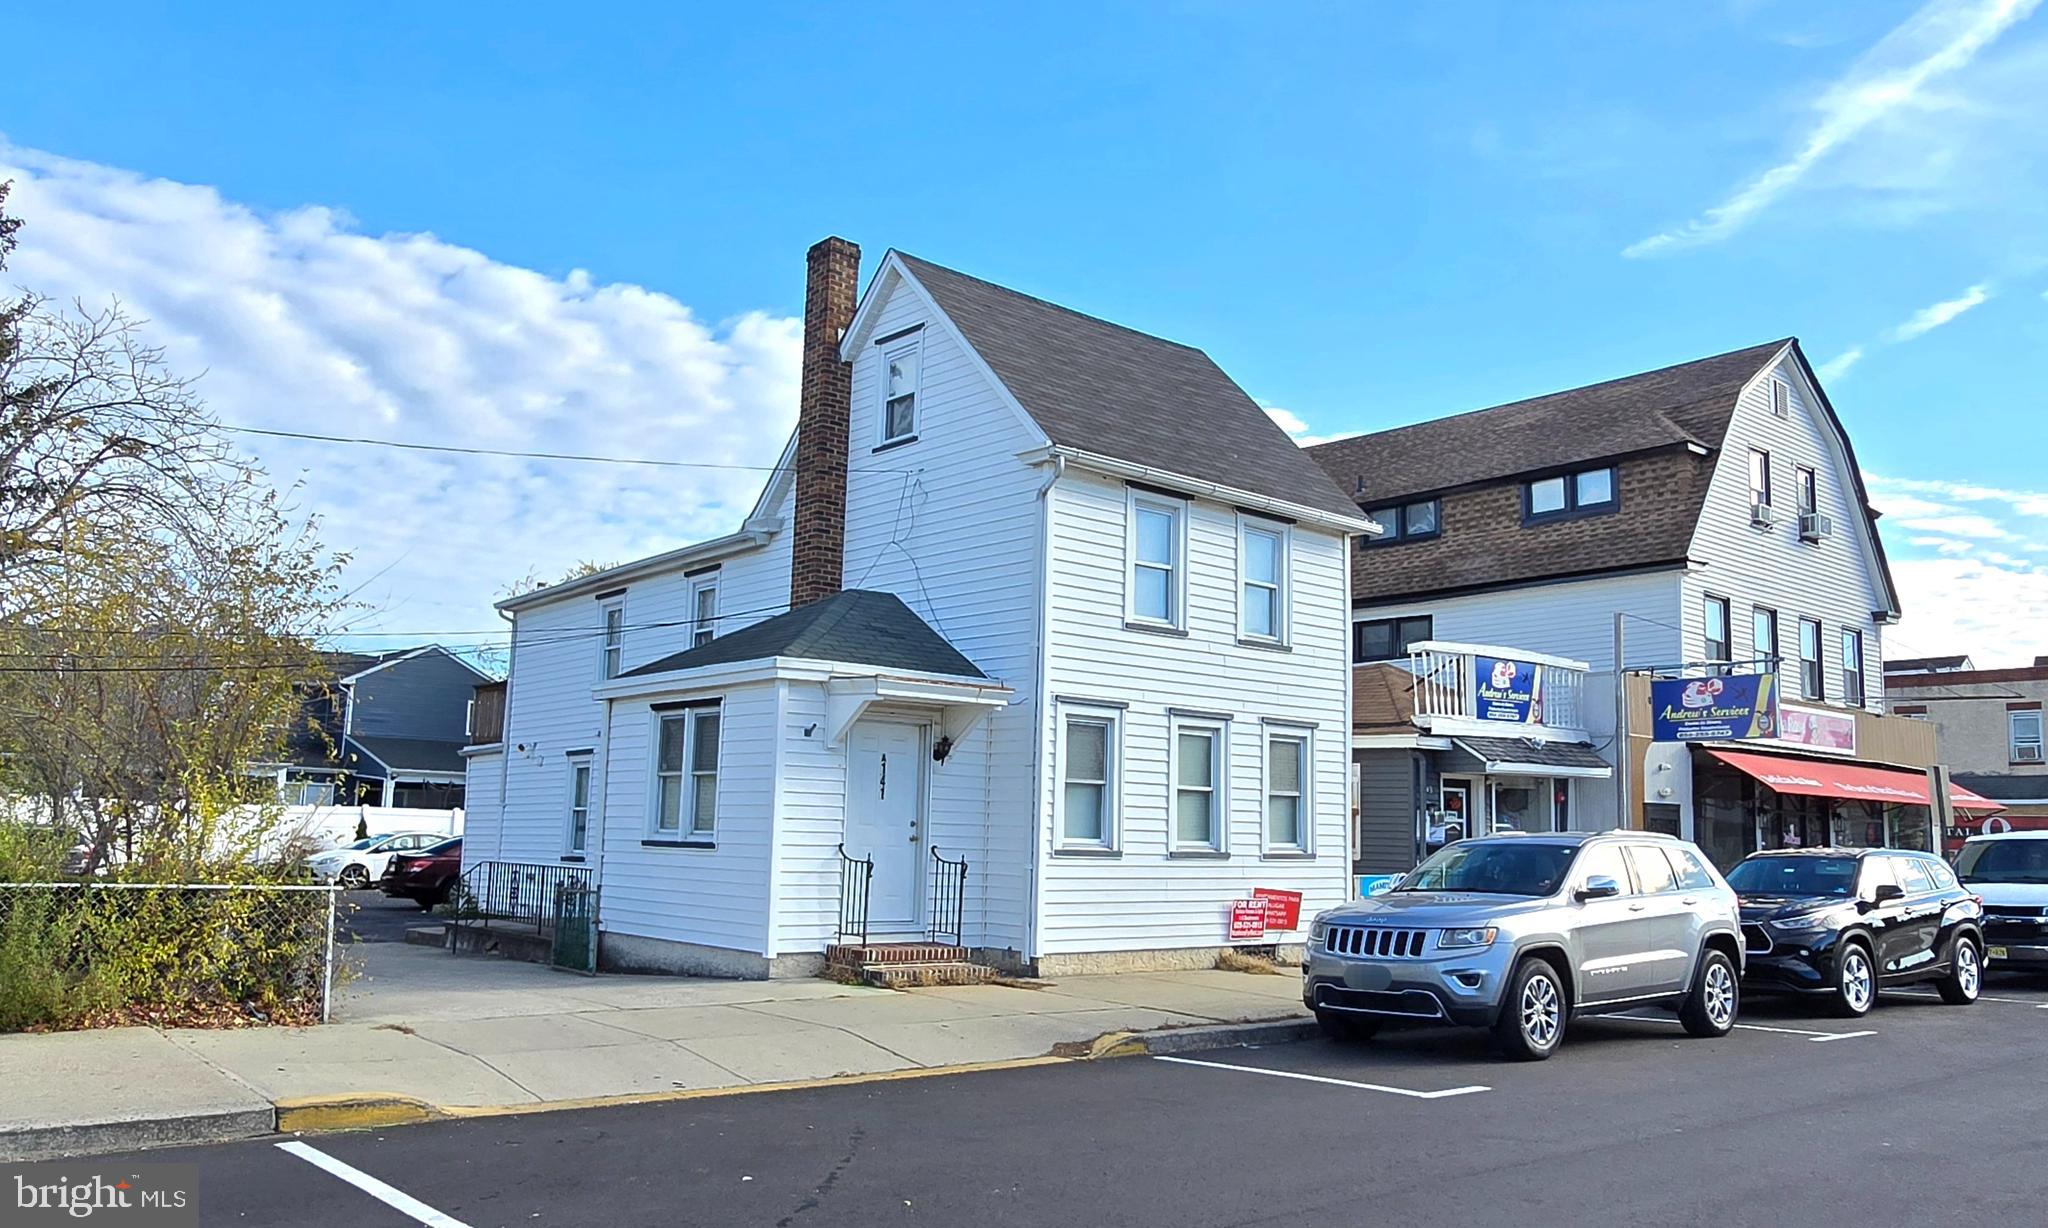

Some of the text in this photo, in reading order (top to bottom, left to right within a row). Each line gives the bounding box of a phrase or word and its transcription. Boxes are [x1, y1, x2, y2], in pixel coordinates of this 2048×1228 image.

[1658, 704, 1750, 721] Andrew's Services
[1947, 827, 1974, 837] TAL
[1233, 900, 1266, 909] FOR RENT
